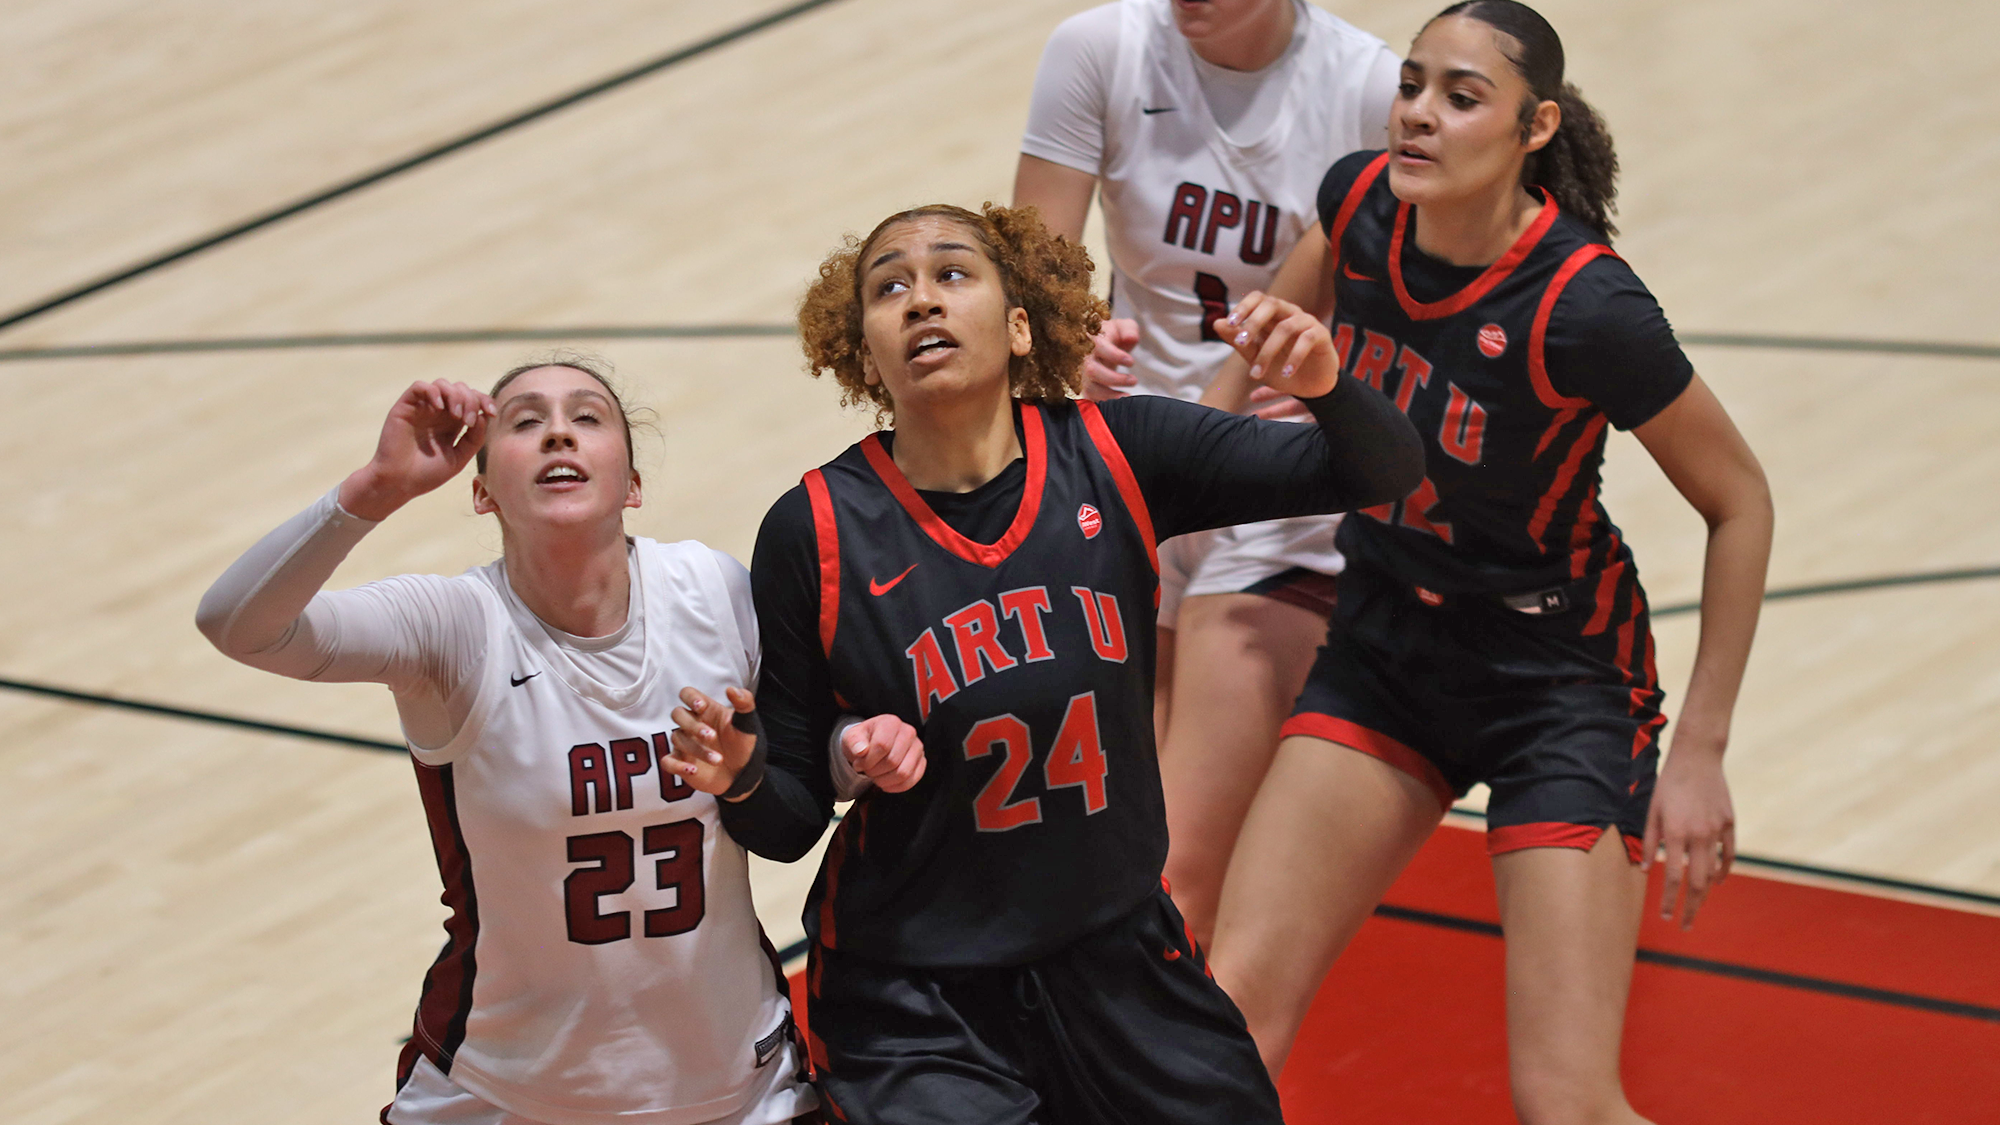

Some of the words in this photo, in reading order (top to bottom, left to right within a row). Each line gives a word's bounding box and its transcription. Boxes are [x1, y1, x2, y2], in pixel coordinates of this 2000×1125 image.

[1163, 181, 1280, 266] APU
[1438, 381, 1489, 466] U
[1546, 595, 1560, 608] M
[905, 585, 1056, 727] ART
[1070, 585, 1130, 665] U
[962, 690, 1109, 833] 24
[563, 817, 706, 946] 23
